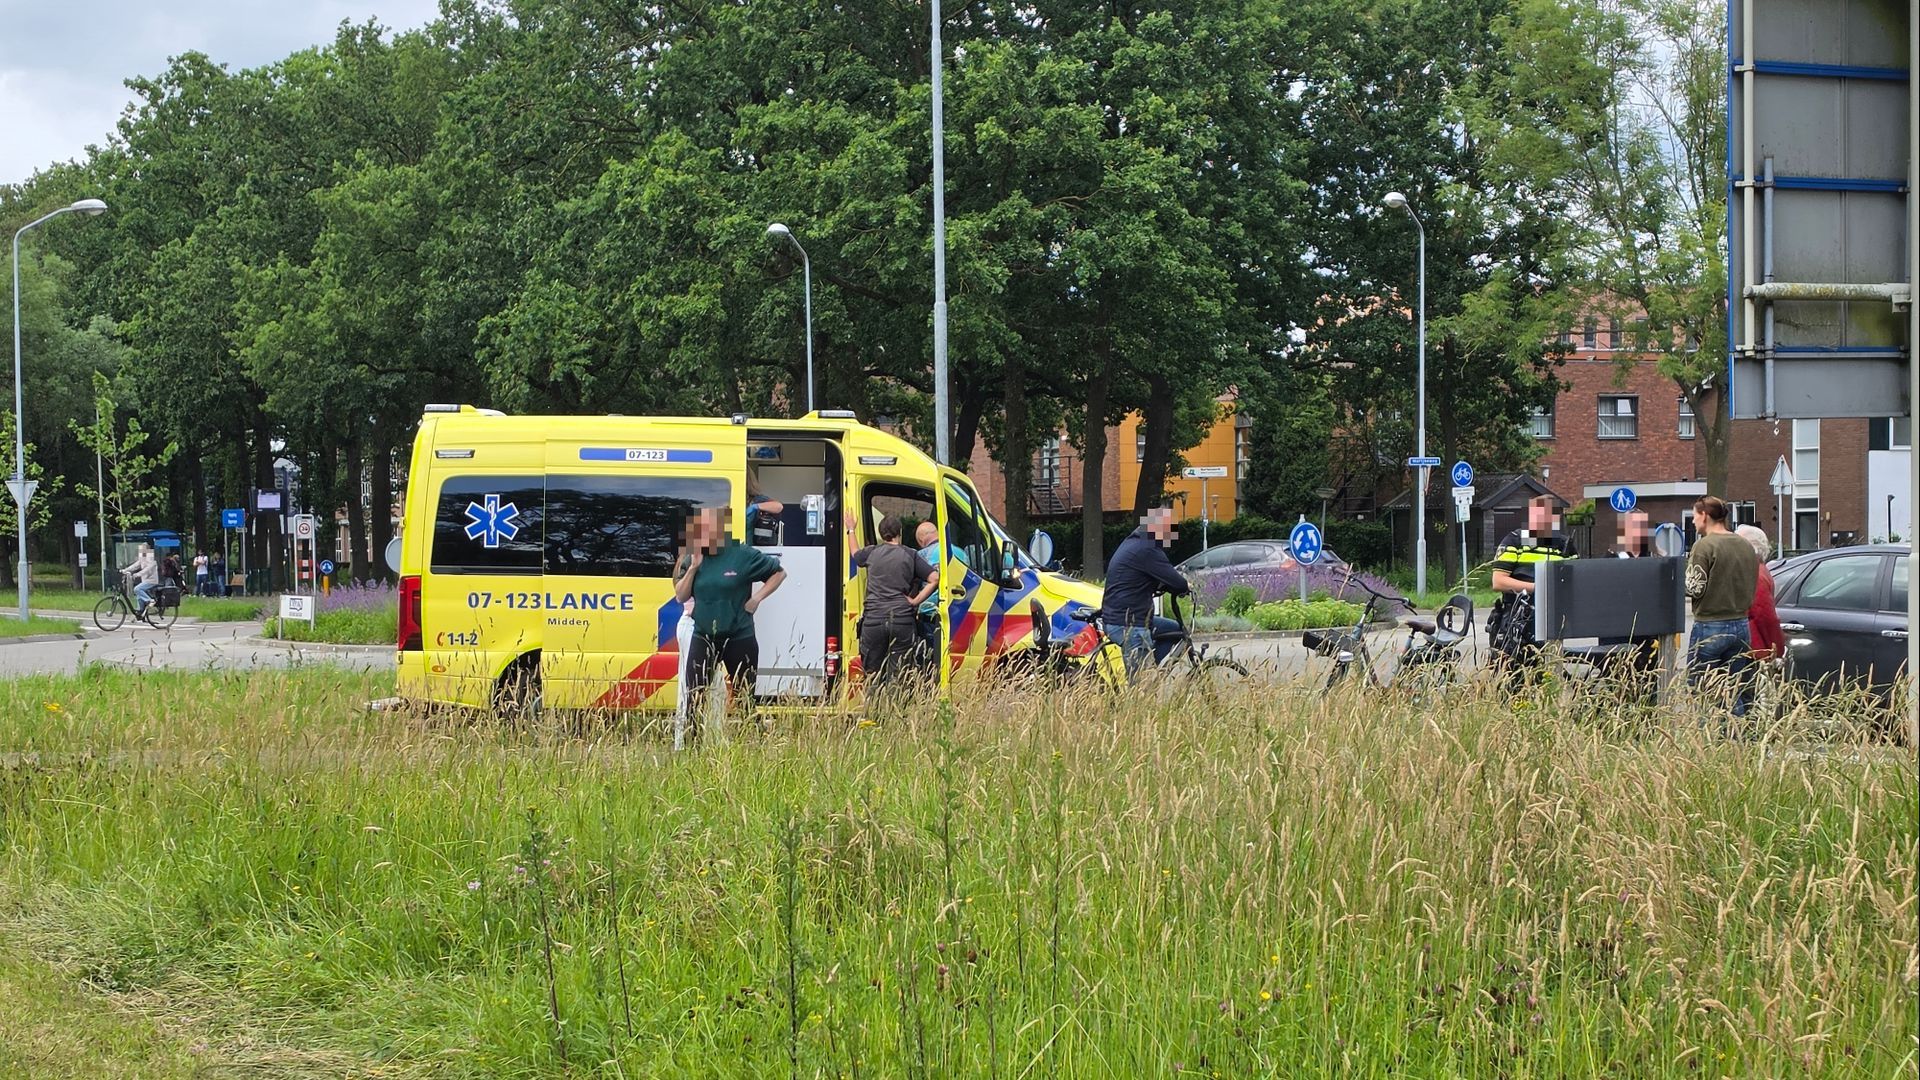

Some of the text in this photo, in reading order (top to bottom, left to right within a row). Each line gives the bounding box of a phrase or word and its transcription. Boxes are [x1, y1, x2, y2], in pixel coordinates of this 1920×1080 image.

[628, 450, 665, 460] 07-123
[467, 592, 634, 610] 07-123 LANCE
[547, 617, 589, 626] Midden
[447, 632, 478, 646] 1-1-2
